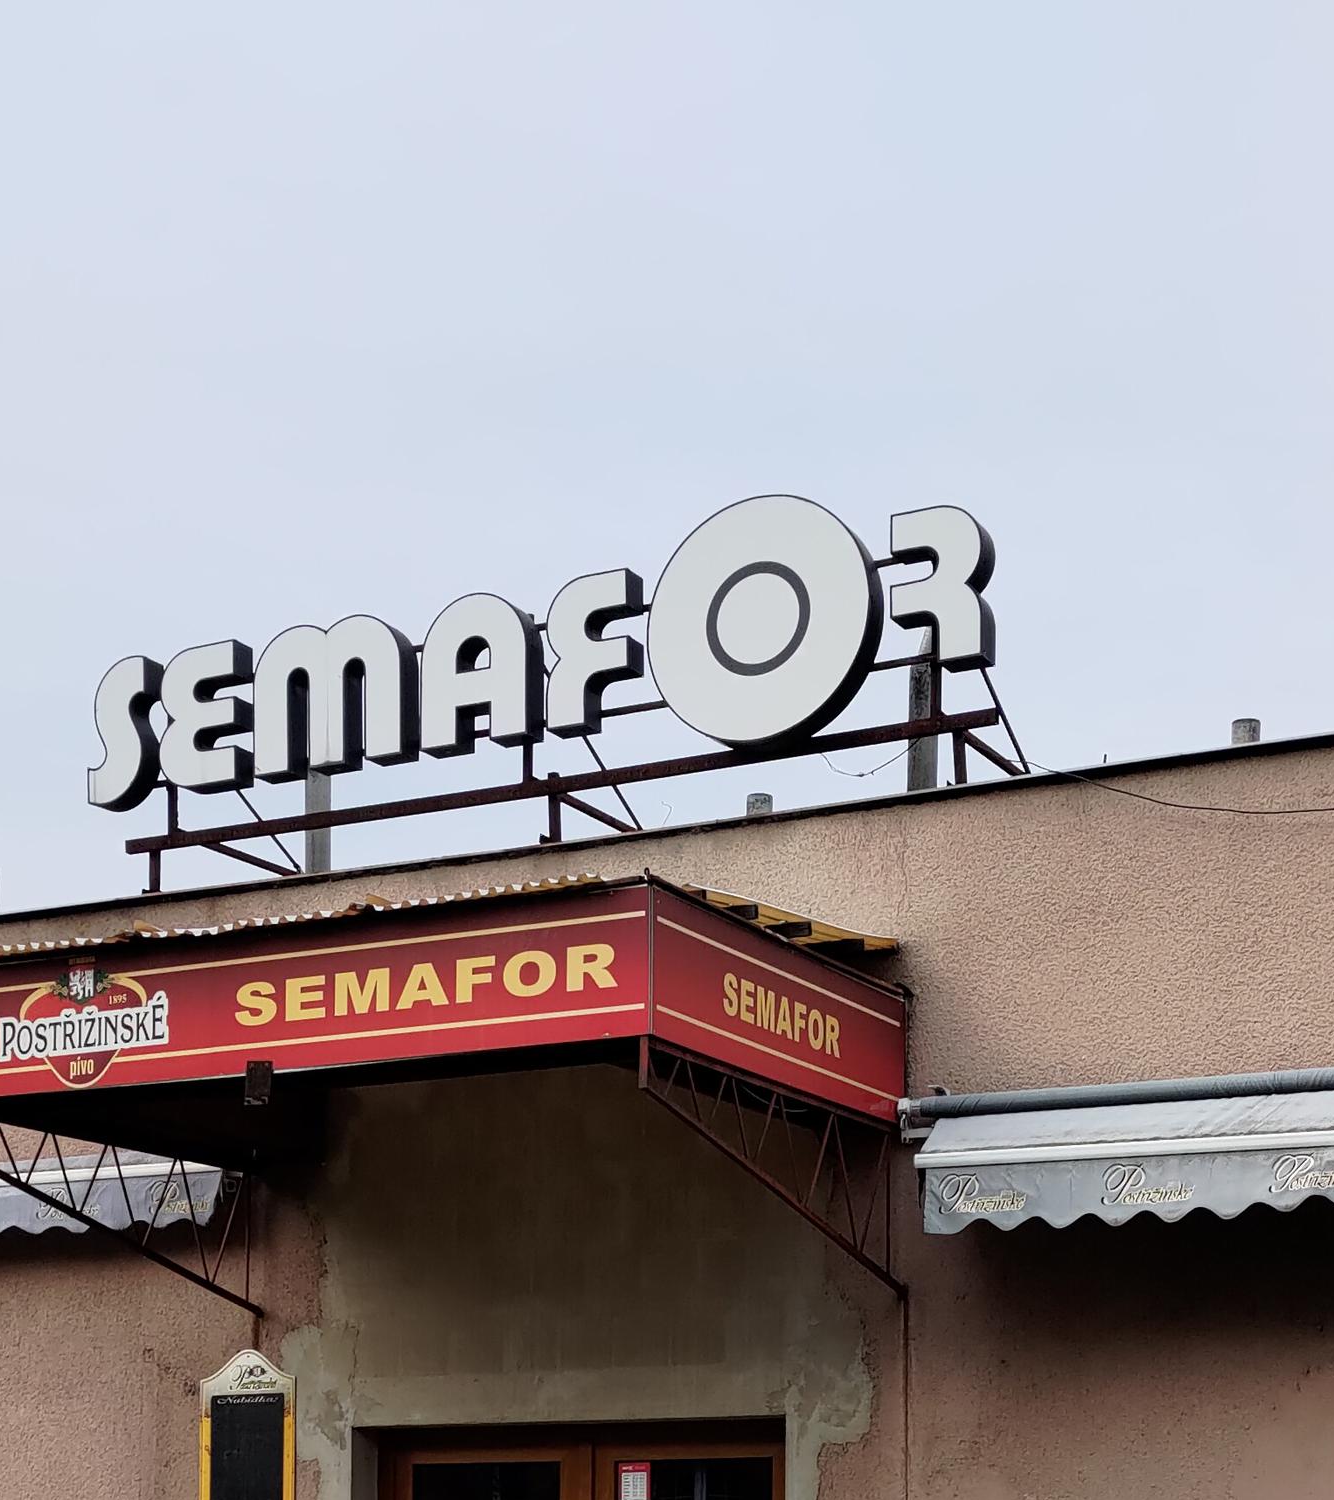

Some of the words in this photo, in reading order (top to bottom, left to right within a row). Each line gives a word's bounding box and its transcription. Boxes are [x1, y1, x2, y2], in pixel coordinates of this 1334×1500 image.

[87, 493, 995, 812] SEMAFOR
[0, 994, 167, 1058] POSTŘIŽINSKÉ
[108, 993, 127, 1005] 1895
[234, 943, 618, 1027] SEMAFOR
[723, 972, 840, 1058] SEMAFOR
